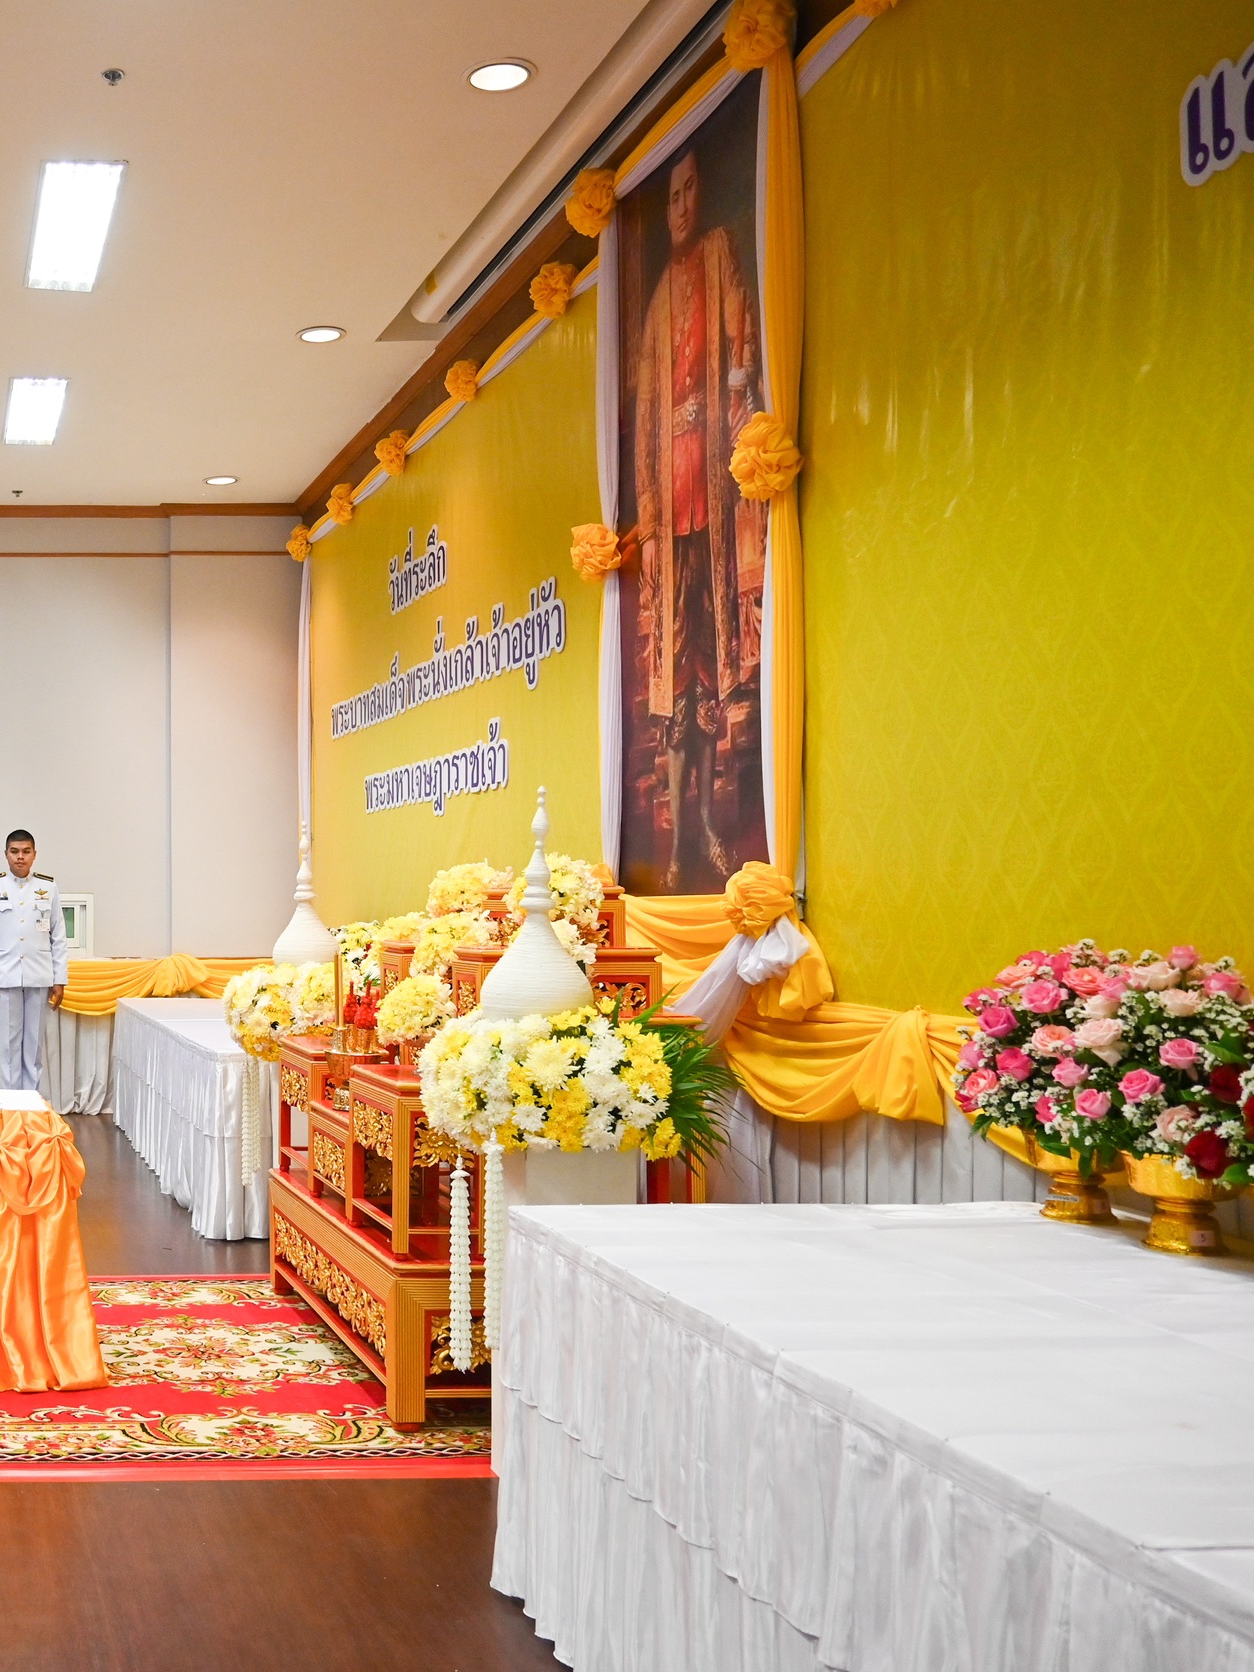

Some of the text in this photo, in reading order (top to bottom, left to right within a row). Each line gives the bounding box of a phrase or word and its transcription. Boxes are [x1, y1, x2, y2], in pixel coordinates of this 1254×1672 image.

[389, 528, 446, 611] วันที่ระลึก
[331, 581, 563, 736] พระบาทสมเด็จพระนั่งเกล้าเจ้าอยู่หัว
[365, 721, 506, 812] พระมหาเจษฎาราชเจ้า
